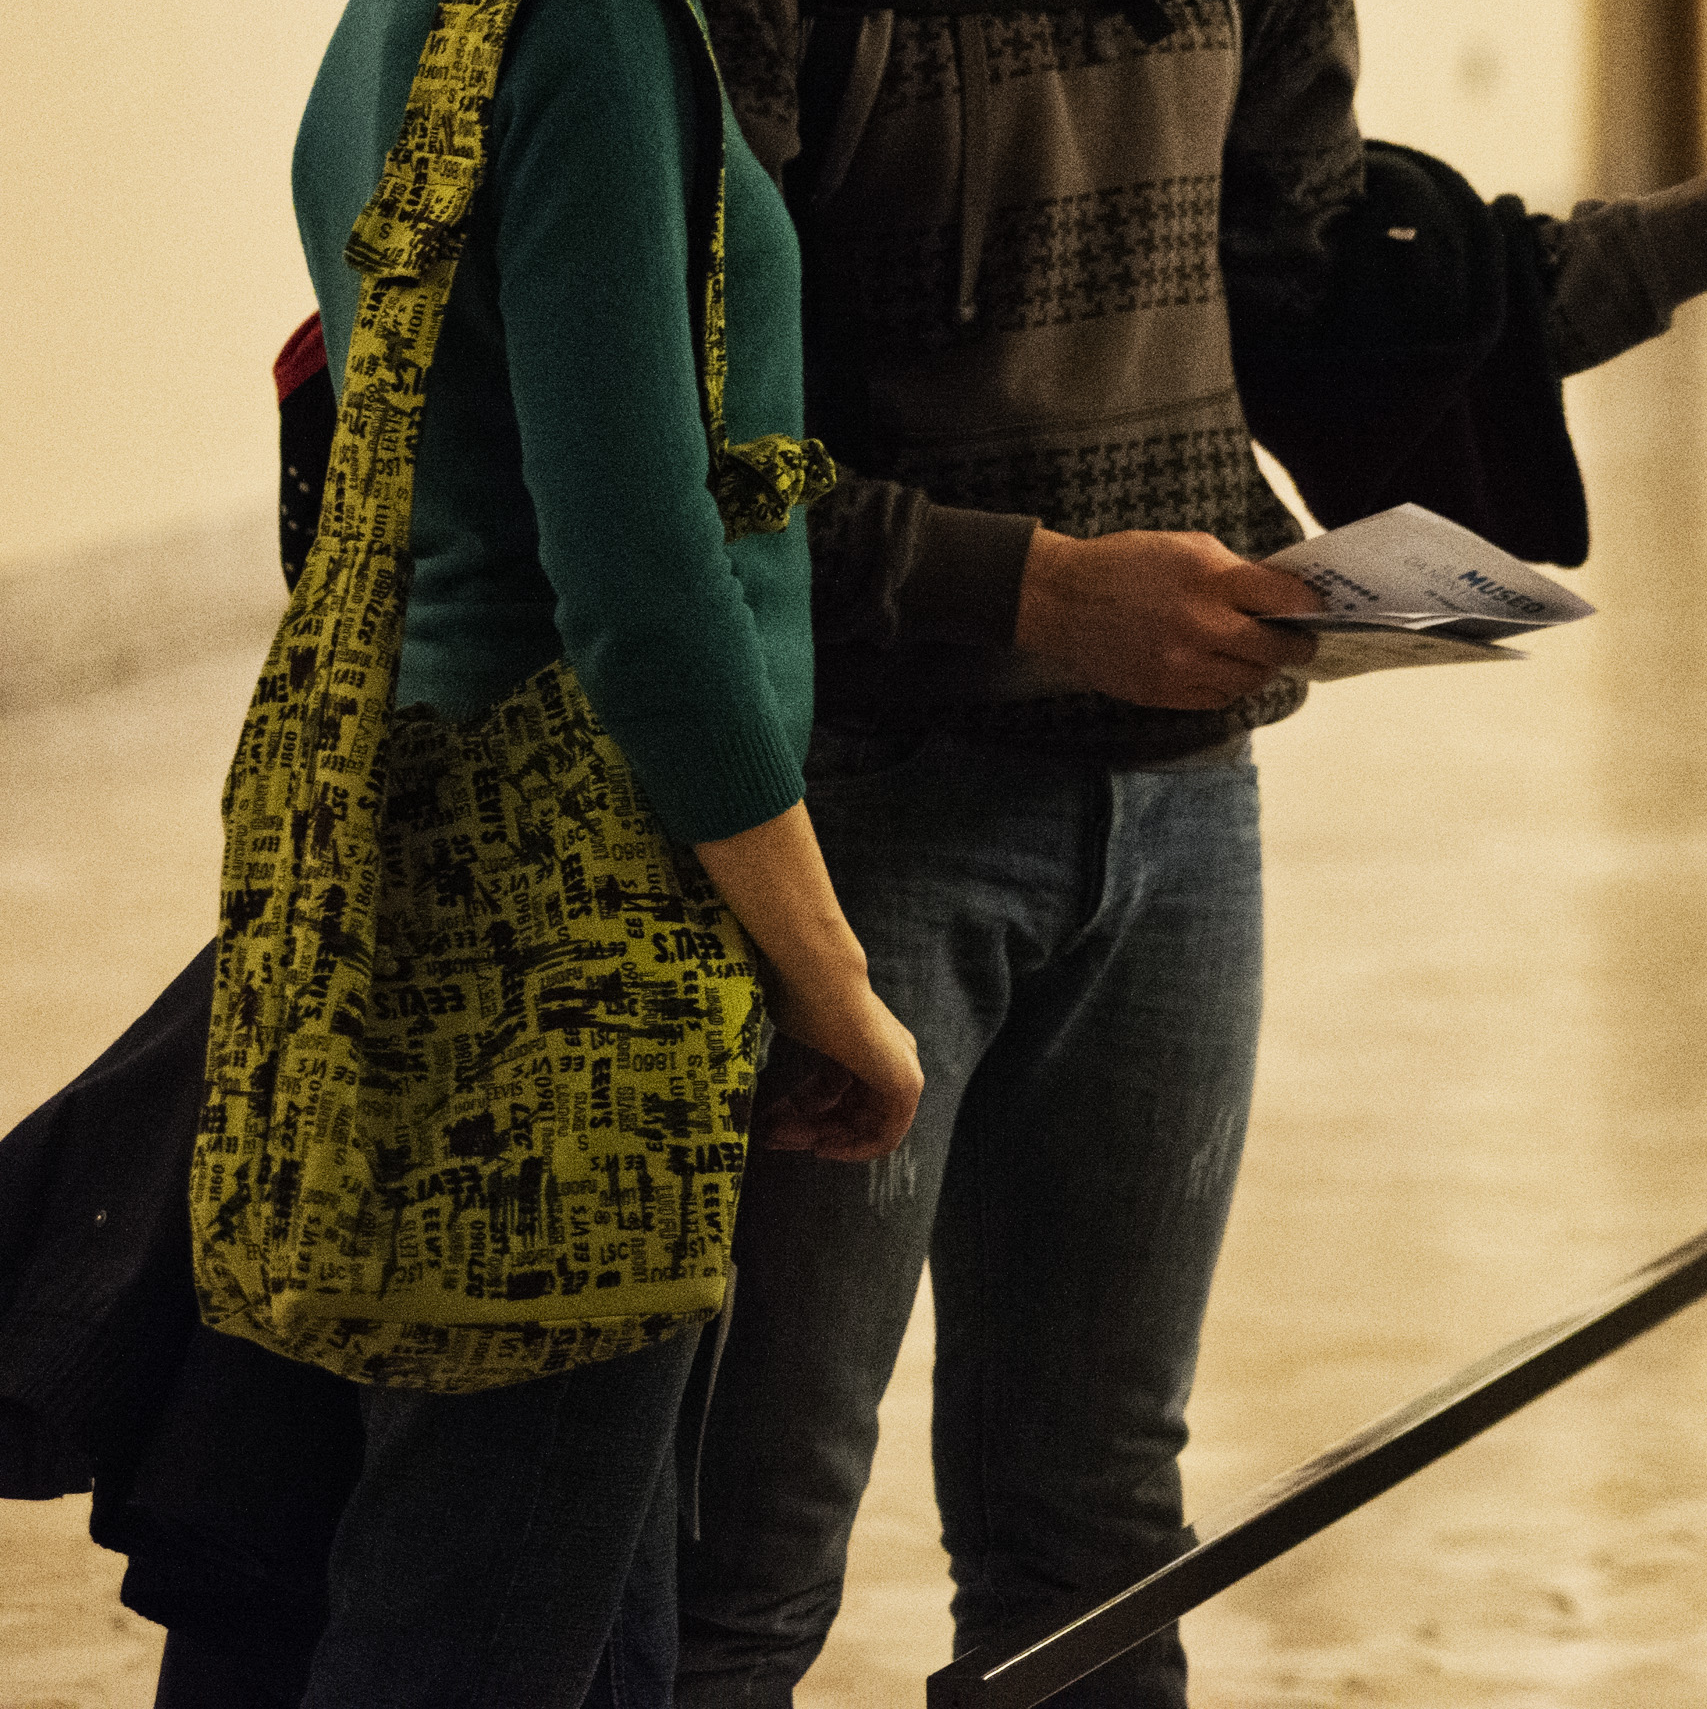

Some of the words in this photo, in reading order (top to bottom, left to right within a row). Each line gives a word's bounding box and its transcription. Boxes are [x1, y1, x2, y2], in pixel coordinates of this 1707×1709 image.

[1459, 570, 1546, 614] MUSEO
[473, 768, 508, 844] EEVI'S
[653, 929, 726, 964] EEVI'S
[373, 984, 467, 1020] EEVI'S
[631, 1052, 676, 1074] 1860
[590, 1057, 612, 1130] EEVI'S
